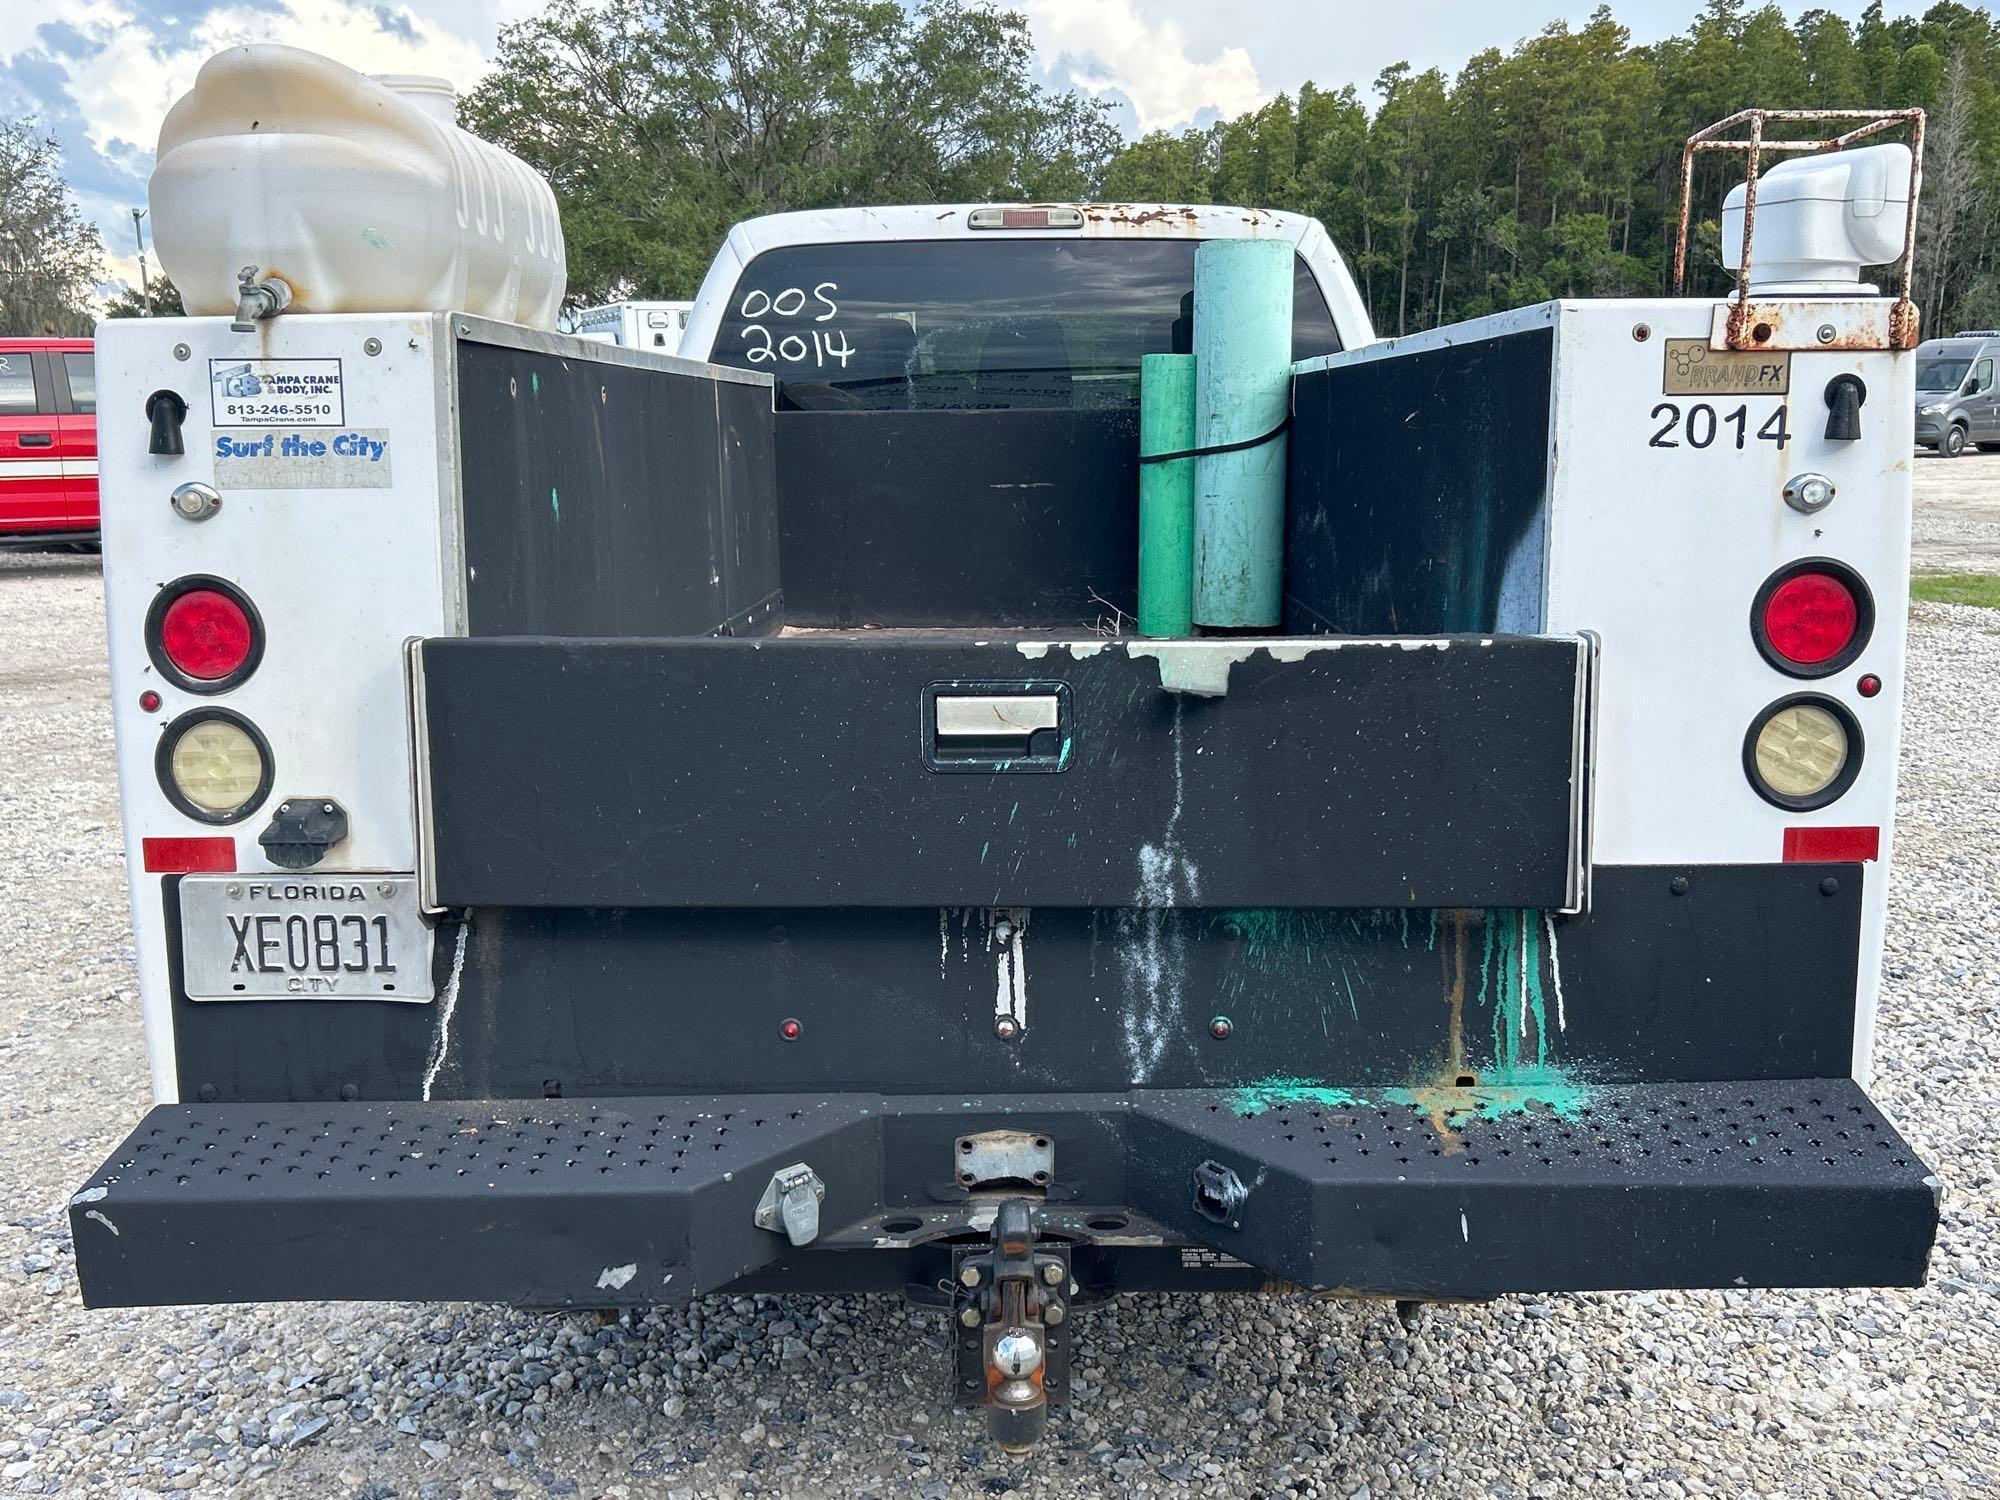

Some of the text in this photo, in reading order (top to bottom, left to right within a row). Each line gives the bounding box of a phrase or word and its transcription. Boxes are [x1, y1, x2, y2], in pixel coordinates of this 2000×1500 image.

[741, 325, 855, 368] 2014
[302, 375, 340, 385] CRANE
[1690, 365, 1784, 382] BRANDFX
[277, 385, 309, 395] BODY,
[310, 385, 333, 394] INC.
[227, 404, 331, 415] 813-246-5510
[1648, 403, 1792, 450] 2014
[215, 433, 388, 462] Surf the City
[250, 885, 367, 901] FLORIDA
[226, 914, 397, 974] XE0831
